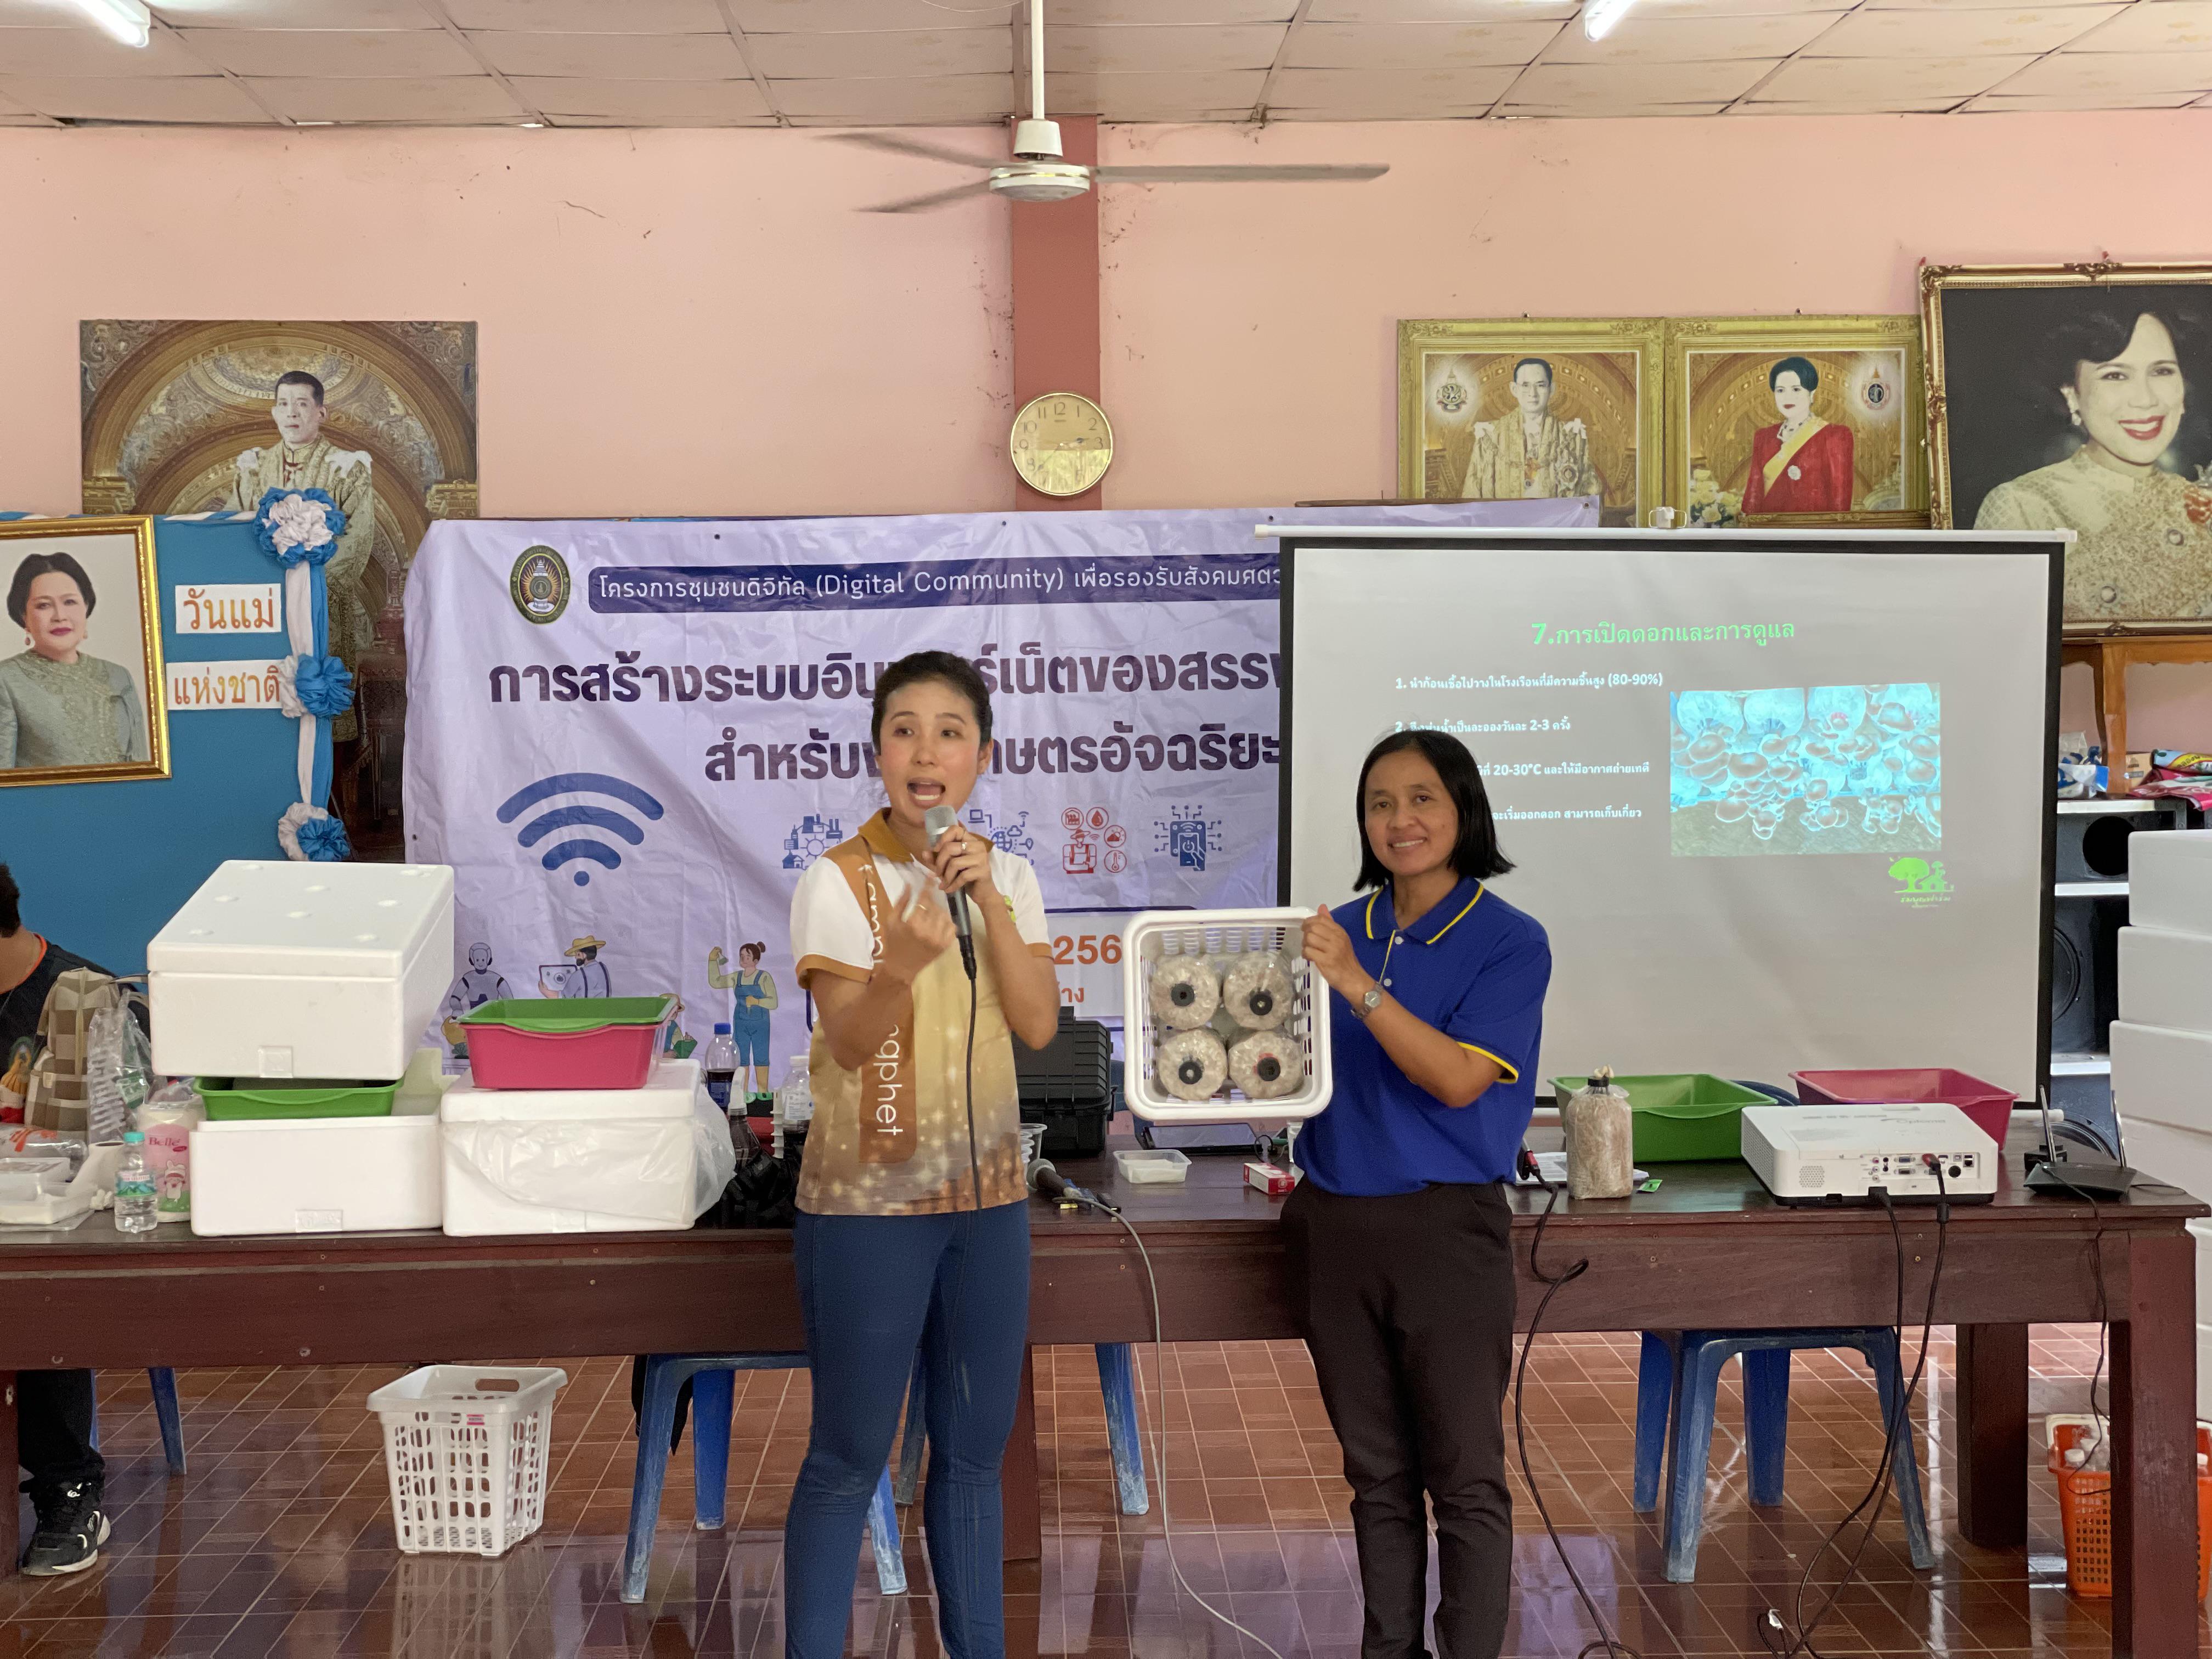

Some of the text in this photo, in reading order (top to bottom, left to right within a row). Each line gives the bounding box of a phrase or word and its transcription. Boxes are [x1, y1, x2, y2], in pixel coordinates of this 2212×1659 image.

[1038, 407, 1046, 419] 11
[1054, 402, 1065, 415] 12
[1024, 420, 1037, 433] 10
[1088, 417, 1097, 431] 2
[1019, 439, 1029, 452] 9
[1094, 437, 1103, 449] 3
[1026, 458, 1036, 471] 8
[600, 573, 805, 602] โครงการชุมชนดิจิทัล
[816, 572, 904, 600] (Digital
[914, 568, 1063, 593] Community)
[183, 587, 275, 629] วันแม่
[174, 665, 280, 704] แห่งชาติ
[1395, 678, 1407, 689] 1.
[1608, 672, 1663, 687] (80-90%)
[1530, 719, 1550, 731] 2-3
[1553, 715, 1571, 730] ครั้ง
[1053, 934, 1122, 965] 256
